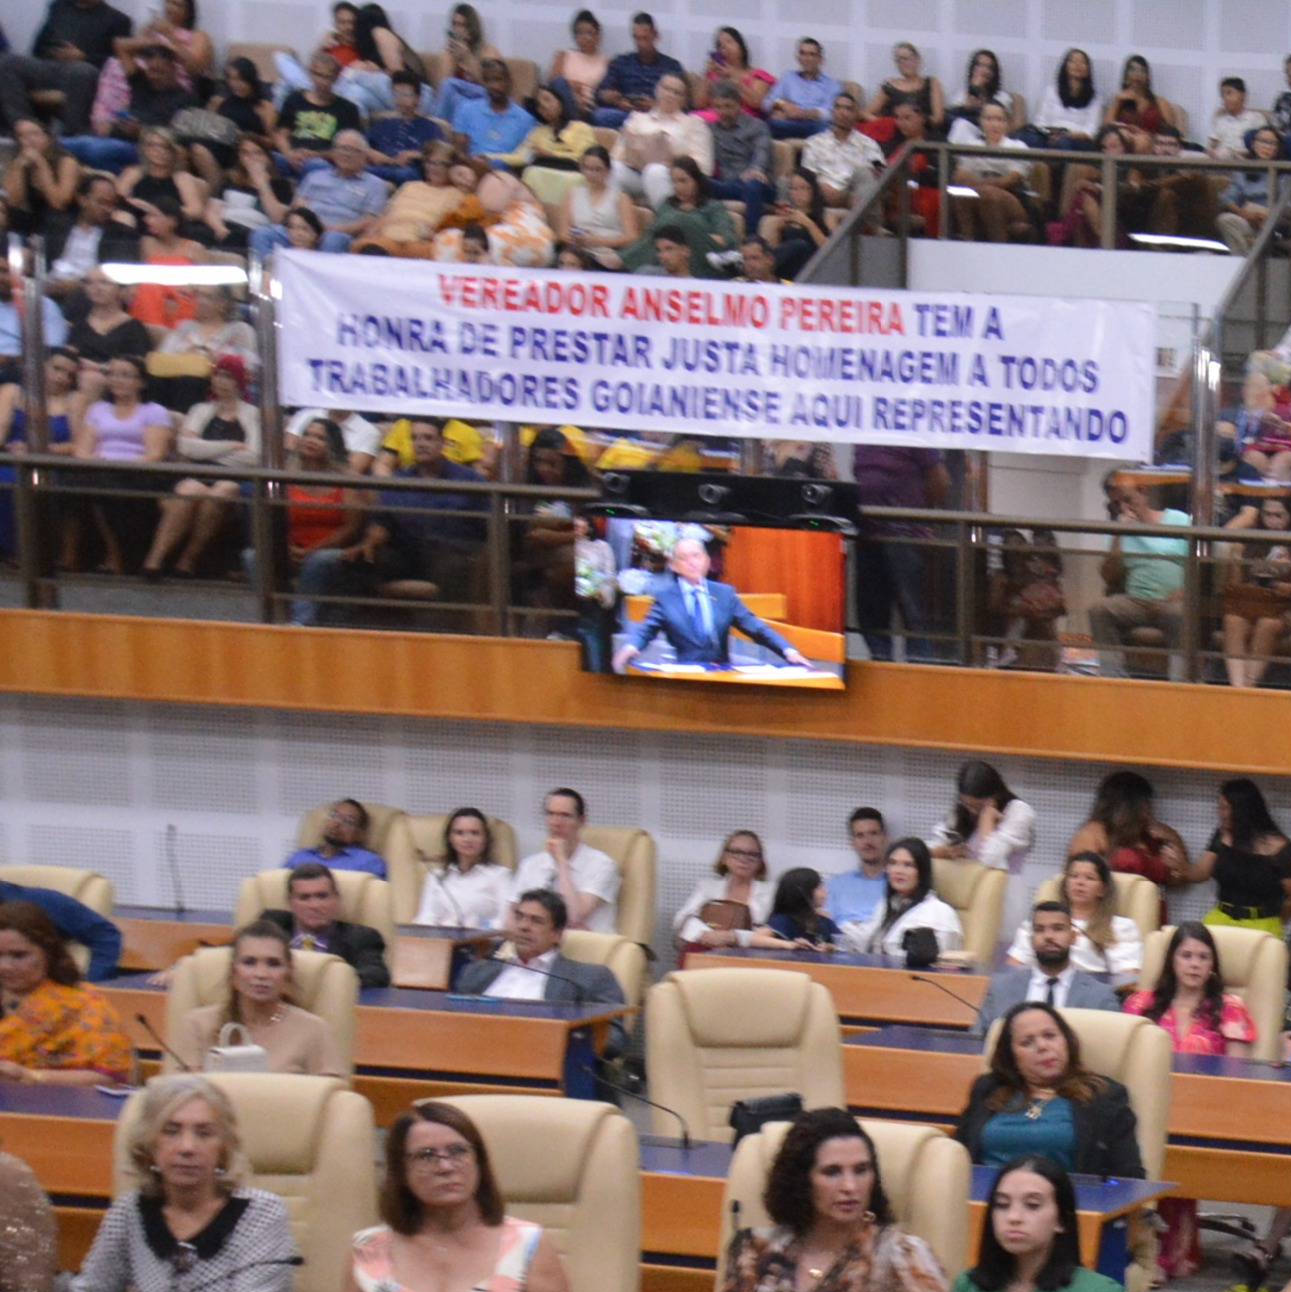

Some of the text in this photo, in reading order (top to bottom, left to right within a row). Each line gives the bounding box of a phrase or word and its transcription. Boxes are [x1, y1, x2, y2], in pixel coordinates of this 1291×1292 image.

[438, 273, 1005, 340] VEREADOR ANSELMO PEREIRA TEM A
[336, 313, 1100, 394] HONRA DE PRESTAR JUSTA HOMENAGEM A TODOS
[306, 358, 1129, 444] TRABALHADORES GOIANIENSE AQUI REPRESENTANDO
